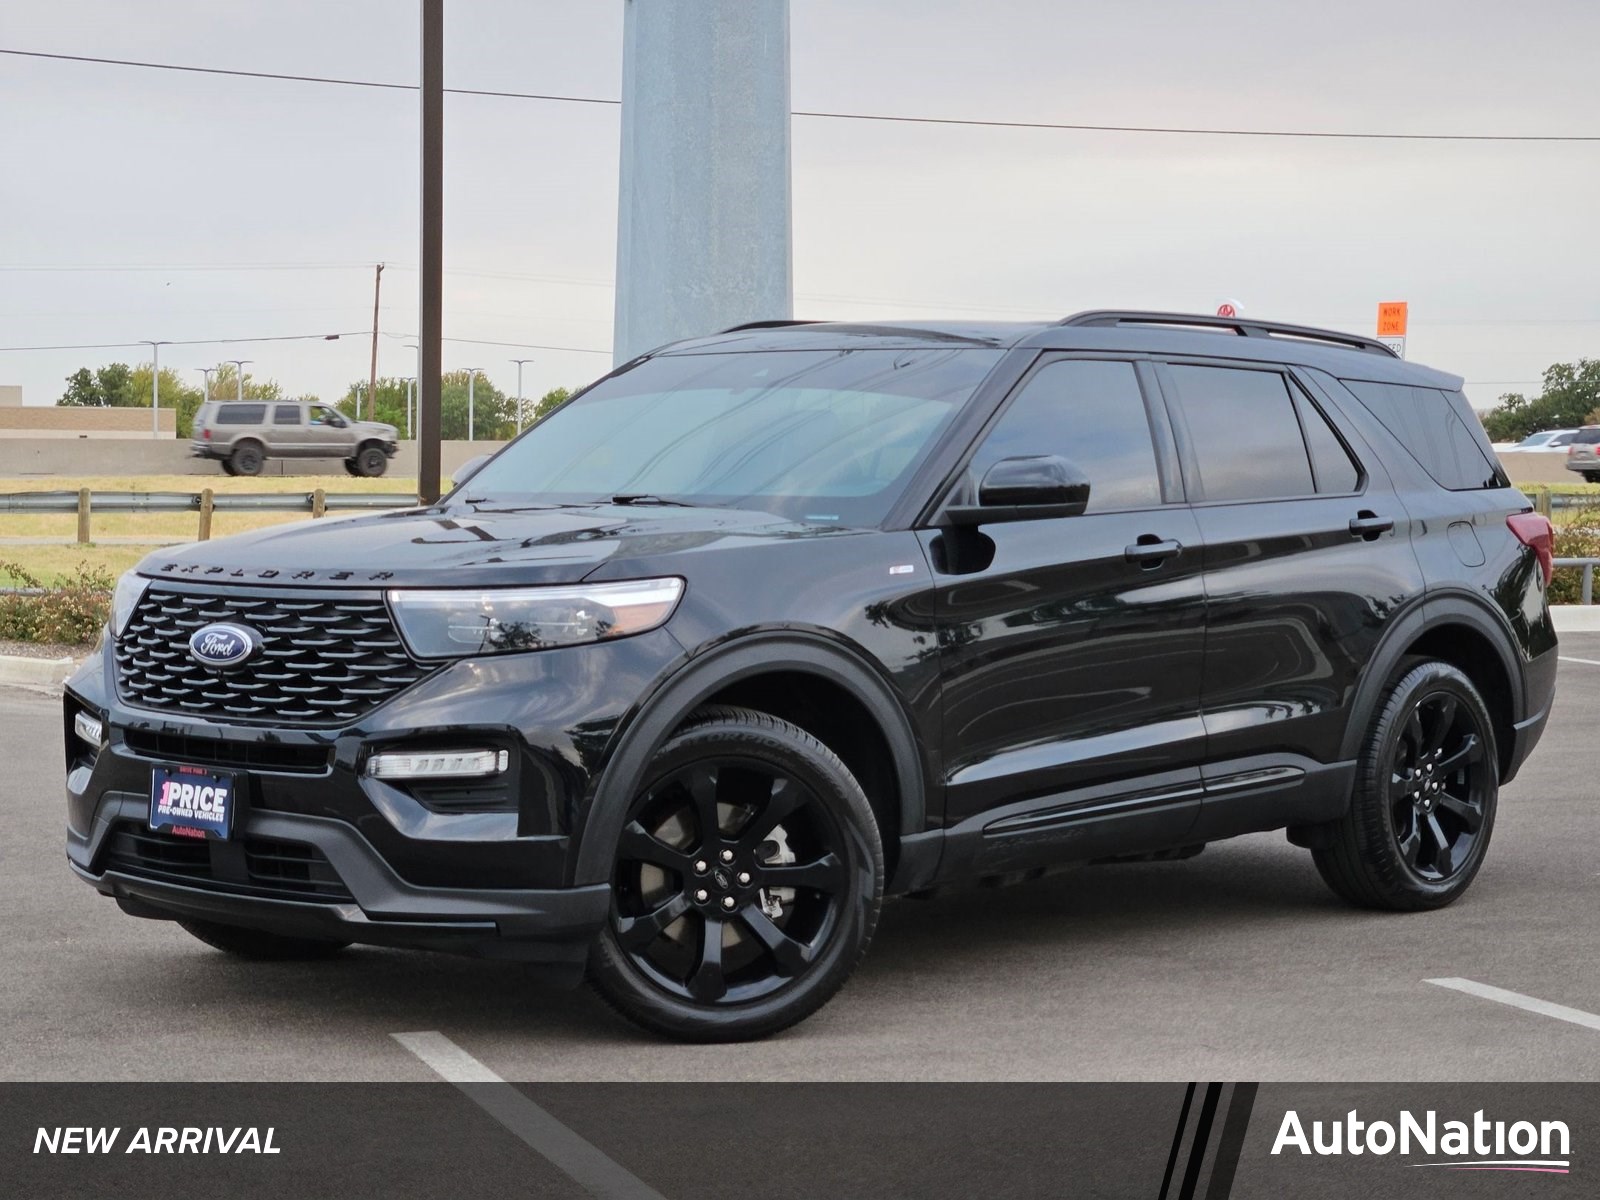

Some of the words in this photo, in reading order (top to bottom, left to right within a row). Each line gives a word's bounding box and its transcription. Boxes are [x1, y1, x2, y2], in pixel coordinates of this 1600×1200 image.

[161, 564, 394, 580] EXPLORER
[201, 632, 235, 656] Ford
[158, 805, 193, 818] PRE-OWNED
[194, 809, 224, 822] VEHICLES
[172, 826, 206, 838] AutoNation
